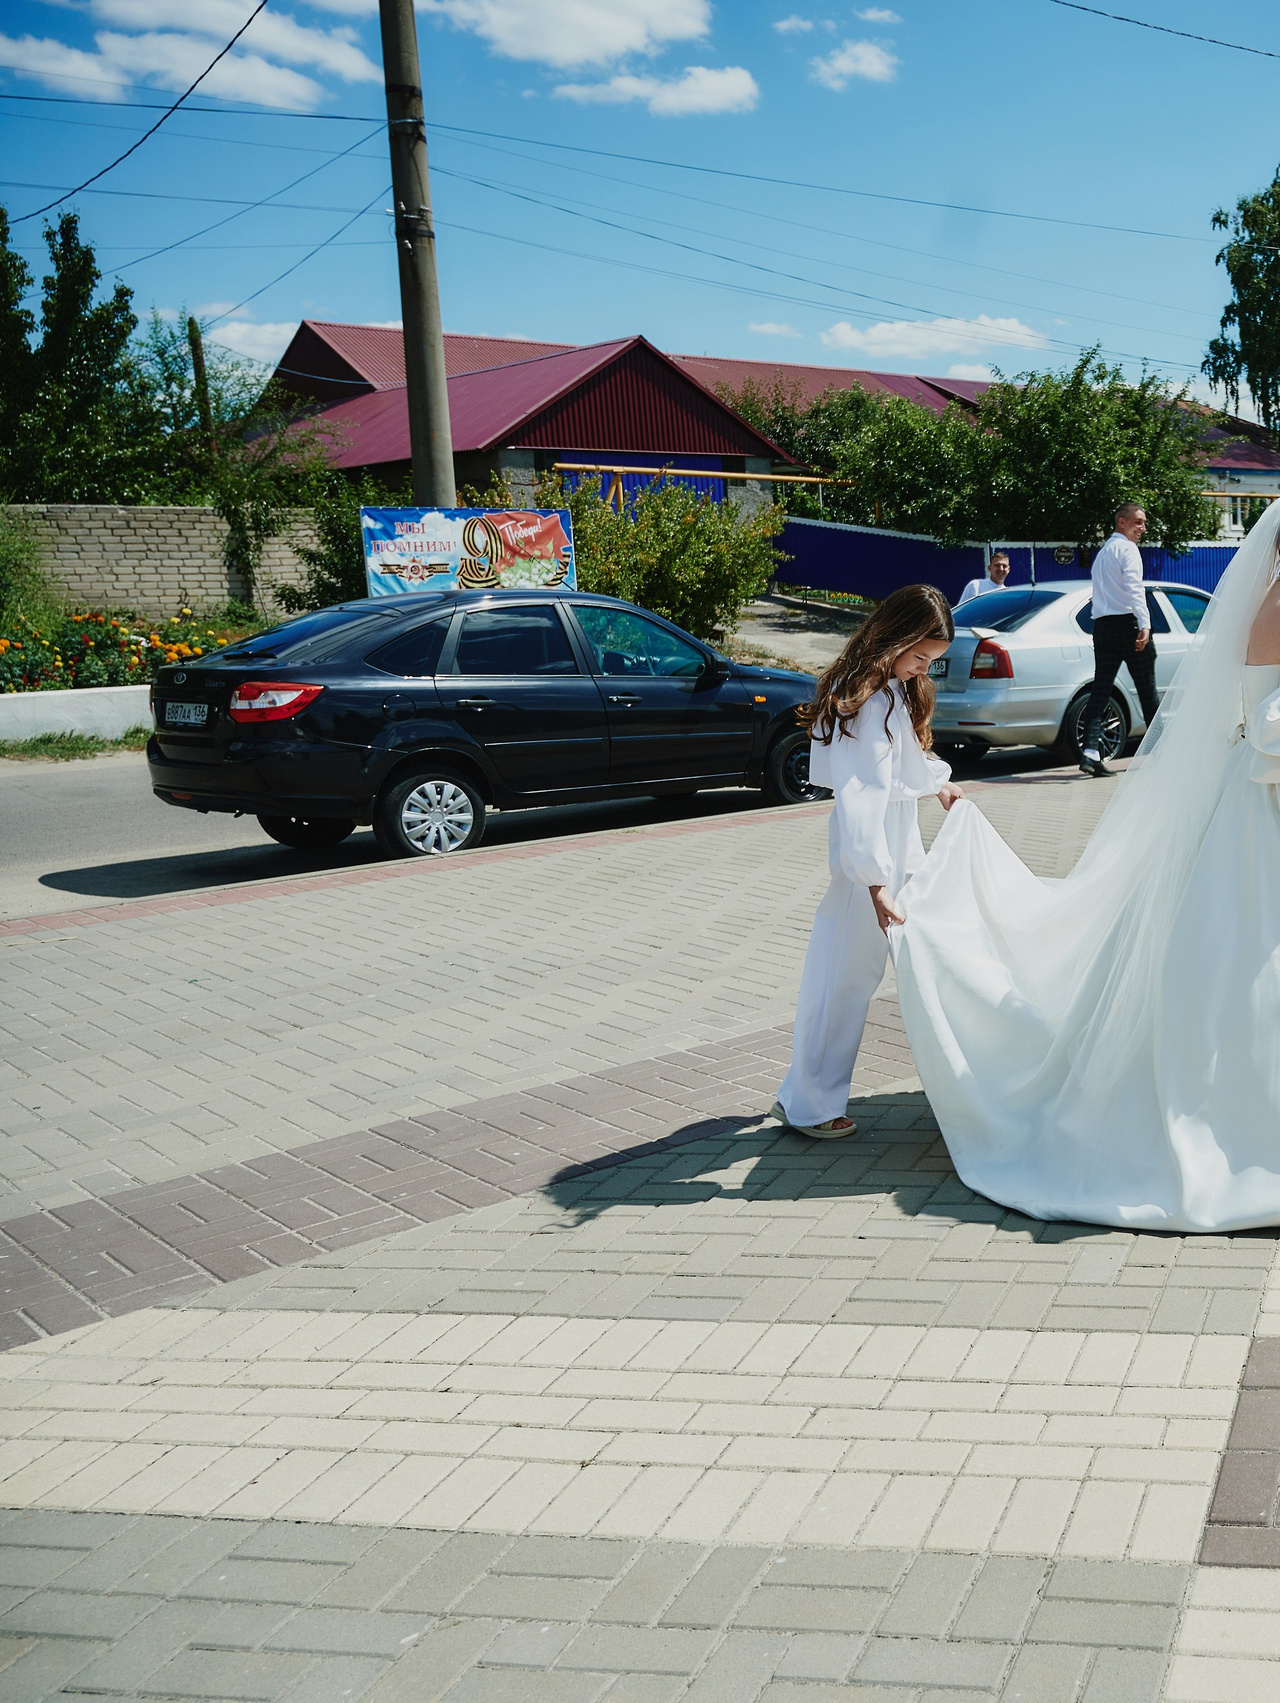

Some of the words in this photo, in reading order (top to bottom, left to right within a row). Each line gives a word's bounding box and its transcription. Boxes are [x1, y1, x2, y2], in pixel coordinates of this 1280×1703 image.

[395, 522, 426, 534] МЫ
[499, 517, 543, 546] Победа!
[372, 540, 457, 553] ПОМНИМ!
[932, 661, 944, 670] 136
[193, 705, 206, 717] 136
